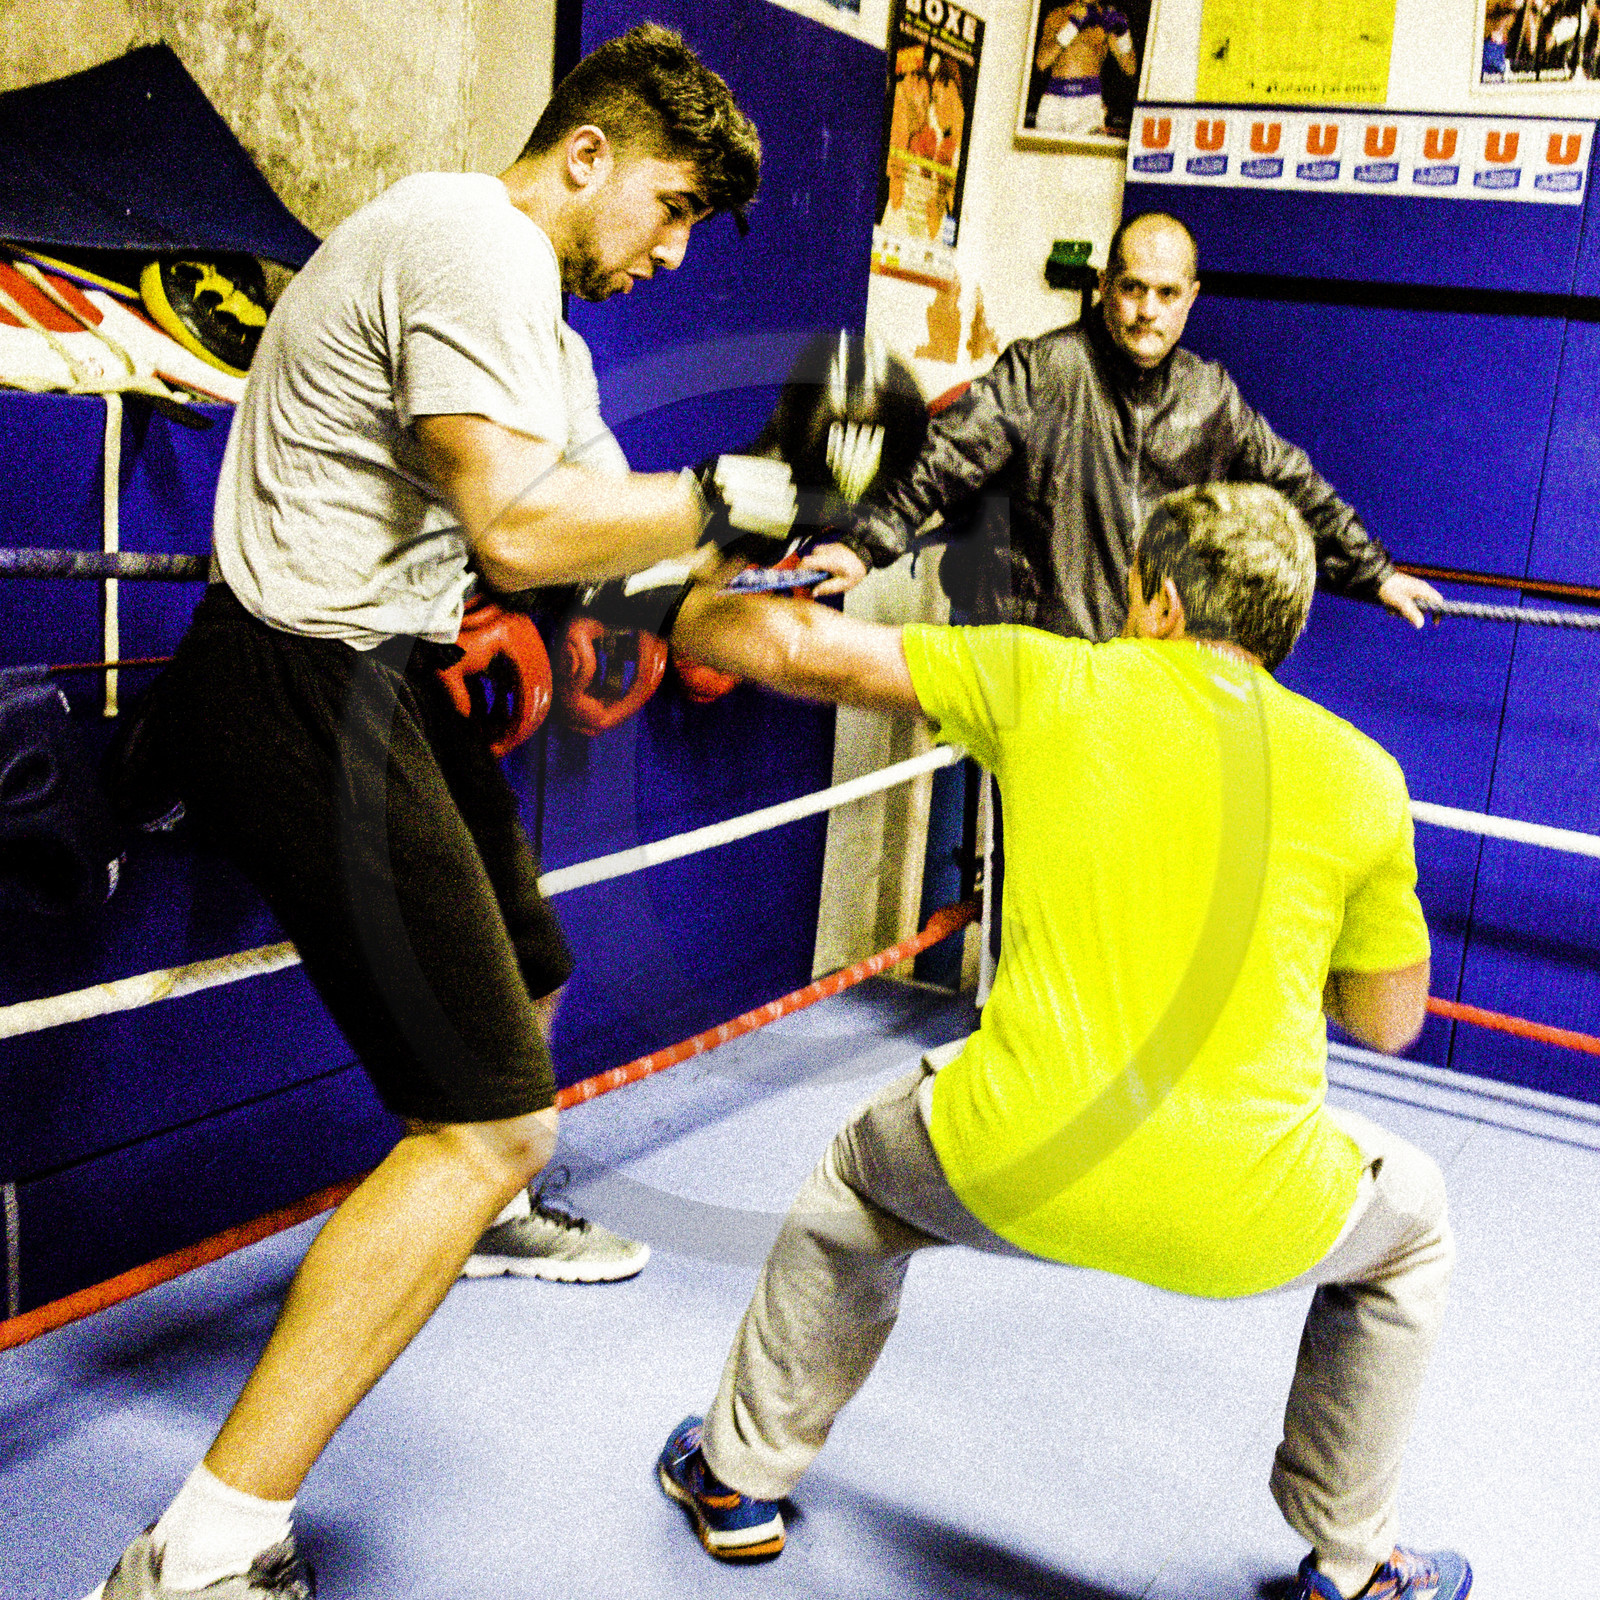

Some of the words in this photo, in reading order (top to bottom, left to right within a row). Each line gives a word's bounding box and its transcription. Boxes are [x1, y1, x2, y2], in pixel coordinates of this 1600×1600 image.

[1141, 117, 1172, 150] U
[1194, 119, 1226, 151] U
[1249, 122, 1282, 154] U
[1306, 124, 1339, 156] U
[1364, 125, 1398, 158] U
[1423, 128, 1458, 160] U
[1484, 131, 1519, 164] U
[1546, 133, 1582, 166] U
